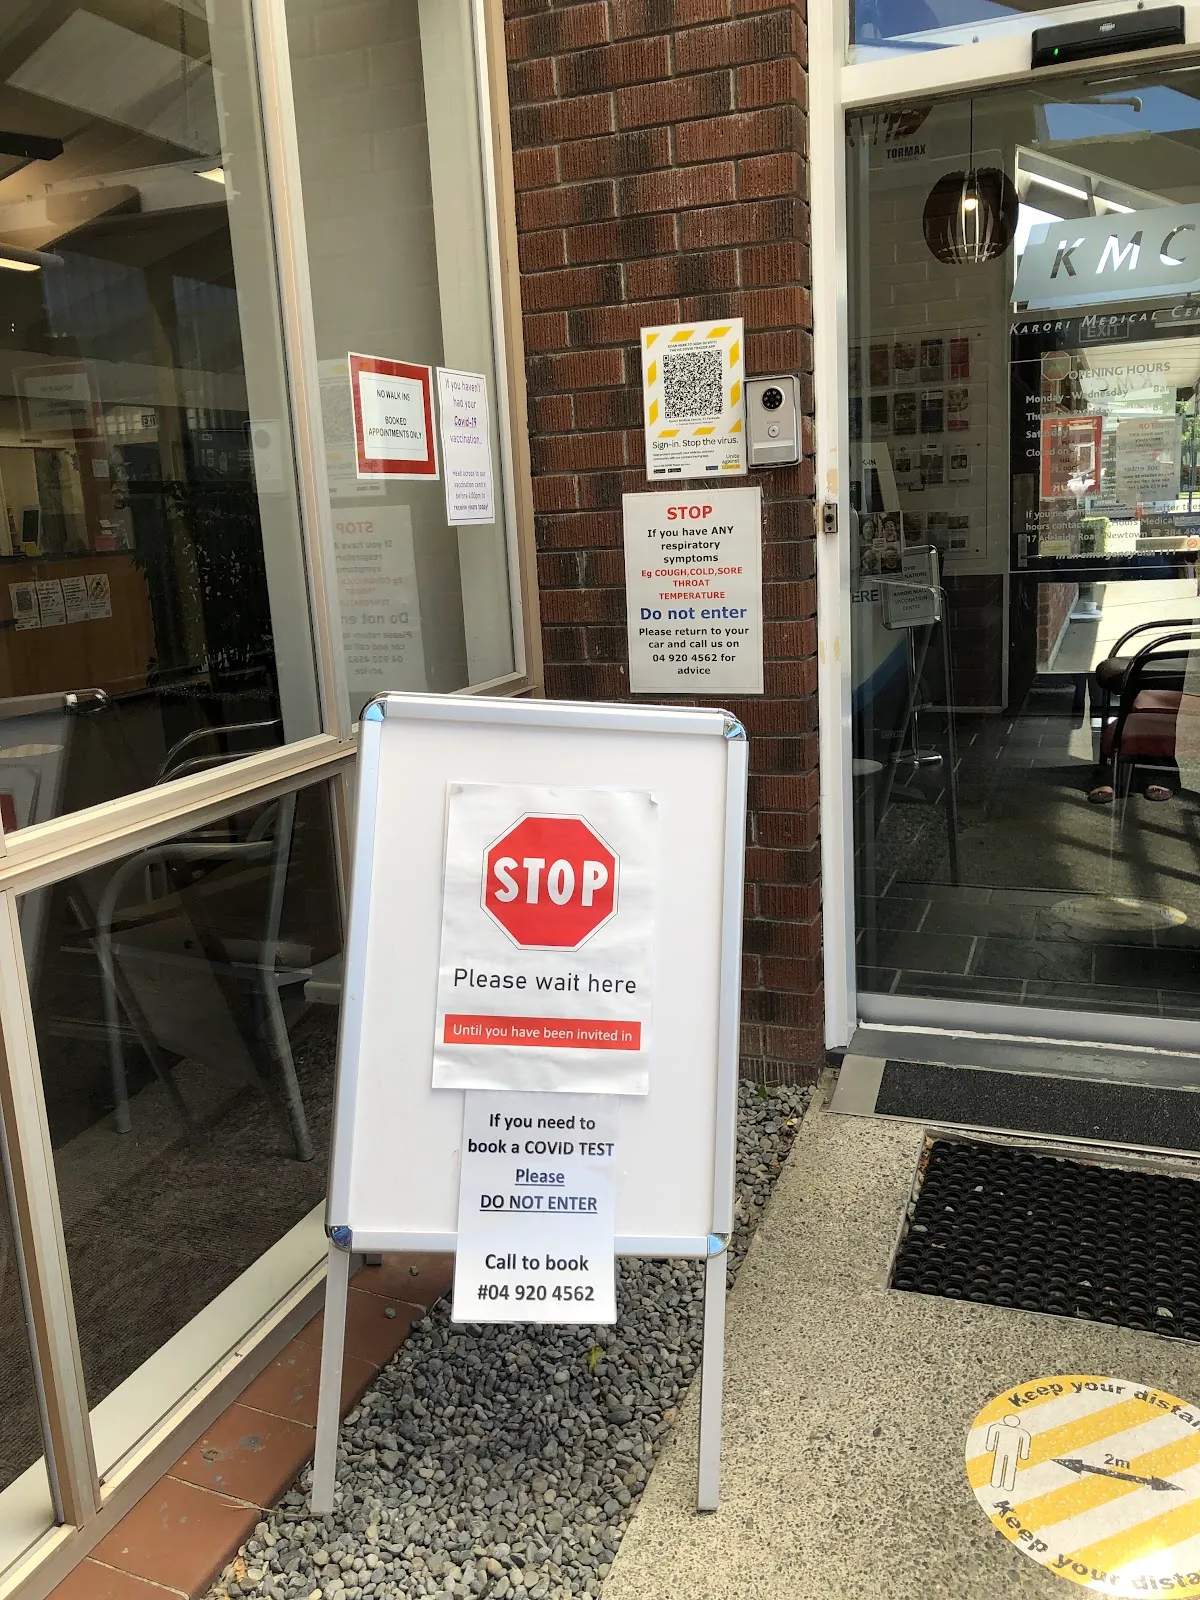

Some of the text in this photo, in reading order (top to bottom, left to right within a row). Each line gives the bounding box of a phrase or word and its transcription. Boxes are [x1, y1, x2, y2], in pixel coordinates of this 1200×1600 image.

[887, 144, 926, 159] TORMAX
[1069, 362, 1171, 380] OPENING HOURS
[376, 389, 386, 398] NO
[386, 390, 401, 400] WALK
[384, 416, 408, 426] BOOKED
[369, 427, 410, 439] APPOINTMENTS
[682, 439, 701, 448] Stop
[702, 438, 716, 446] the
[717, 437, 739, 445] virus.
[667, 505, 713, 520] STOP
[648, 526, 735, 539] If you have ANY
[1026, 523, 1050, 531] hours
[1107, 531, 1148, 539] Newtown
[661, 540, 721, 552] respiratory
[663, 554, 719, 565] symptoms
[641, 567, 743, 579] Eg COUGH,COLD,SORE
[673, 579, 711, 588] THROAT
[659, 592, 726, 601] TEMPERATURE
[640, 607, 748, 620] Do not enter
[639, 627, 750, 638] Please return to your
[649, 641, 664, 649] car
[668, 640, 687, 649] and
[690, 640, 707, 649] call
[652, 653, 737, 663] 04 920 4562 for
[677, 666, 711, 676] advice
[493, 856, 609, 907] STOP
[454, 968, 637, 994] Please wait here
[453, 1023, 632, 1042] Until you have been invited in
[489, 1114, 596, 1131] If you need to
[468, 1139, 615, 1157] book a COVID TEST
[515, 1168, 565, 1186] Please
[480, 1195, 598, 1212] DO NOT ENTER
[485, 1254, 589, 1272] Call to book
[478, 1284, 595, 1302] #04 920 4562
[1008, 1382, 1064, 1408] Keep
[1070, 1381, 1128, 1396] your
[1104, 1453, 1131, 1470] 2m
[993, 1500, 1049, 1553] Keep
[1053, 1553, 1120, 1586] your
